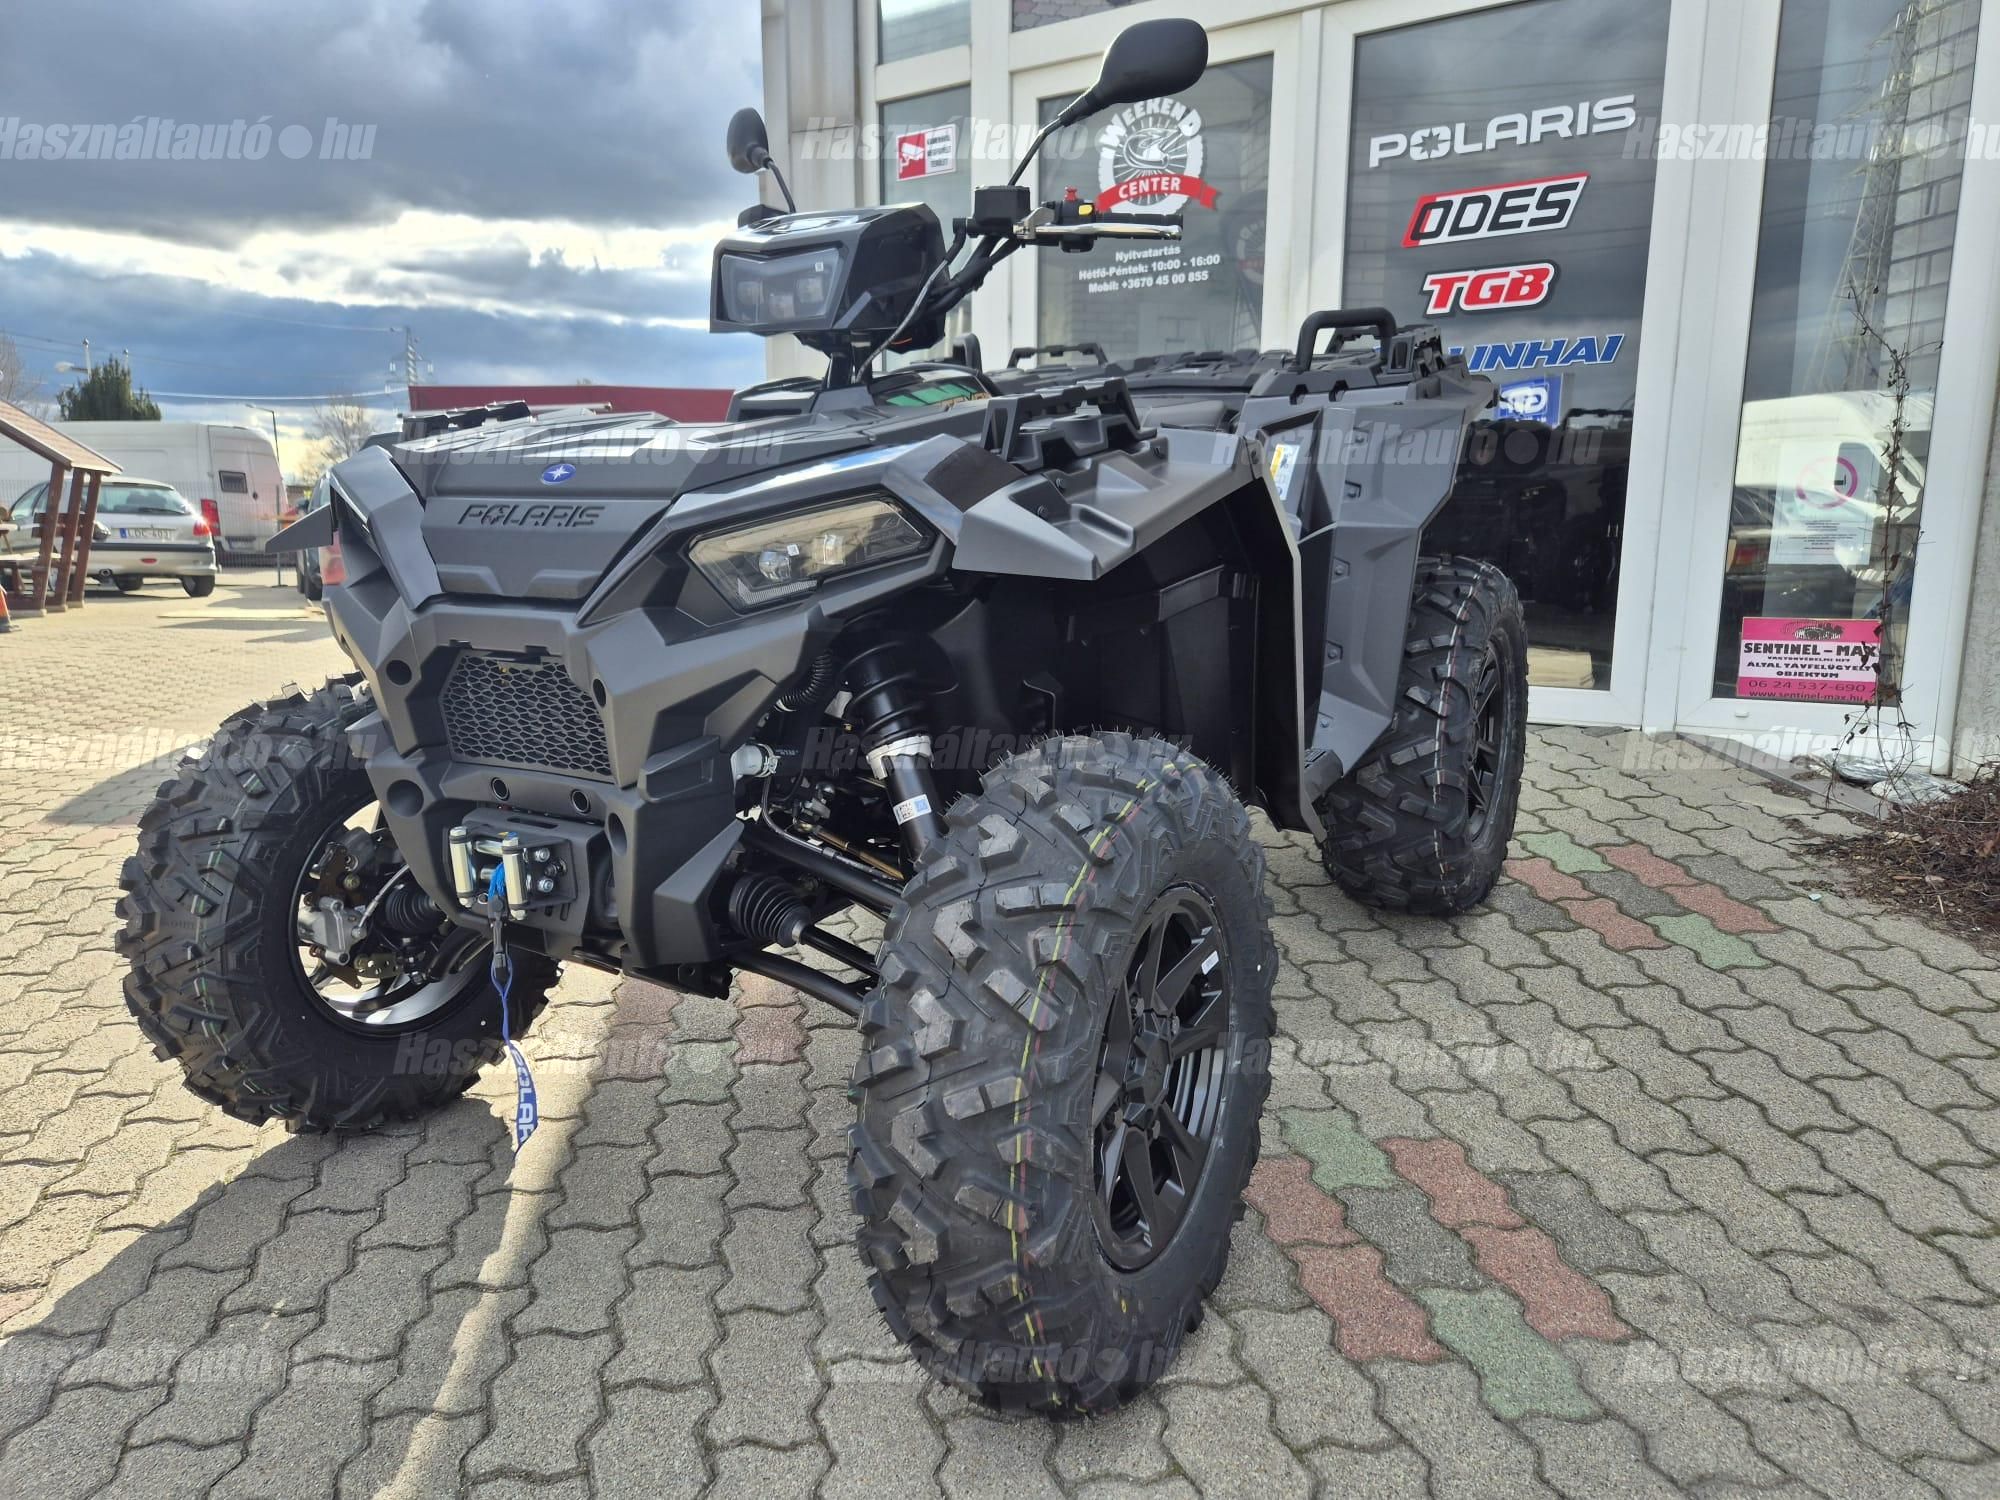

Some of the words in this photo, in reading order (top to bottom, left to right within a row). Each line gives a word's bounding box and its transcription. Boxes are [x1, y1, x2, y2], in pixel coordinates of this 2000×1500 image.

[1099, 97, 1202, 147] WEEKEND
[1369, 94, 1636, 168] POLARIS
[1118, 177, 1181, 199] CENTER
[1410, 181, 1580, 241] ODES
[1115, 245, 1182, 262] Nyitvatartás
[1151, 259, 1181, 272] 10:00
[1190, 254, 1220, 268] 16:00
[1088, 281, 1119, 293] Mobil:
[1121, 277, 1153, 289] +3670
[1155, 274, 1169, 285] 45
[1171, 273, 1185, 284] 00
[1188, 270, 1209, 282] 855
[1427, 264, 1553, 311] TGB
[1449, 334, 1625, 372] INHAI
[457, 503, 606, 528] POLARIS
[1743, 642, 1821, 656] SENTINEL
[1836, 645, 1877, 657] MAX
[1747, 661, 1783, 669] ÁLTAL
[1776, 670, 1839, 679] OBJEKTUM
[1748, 680, 1768, 689] 06
[1772, 680, 1793, 690] 24
[1798, 681, 1867, 692] 537-690
[1749, 691, 1864, 702] www.sentinel-max.hu
